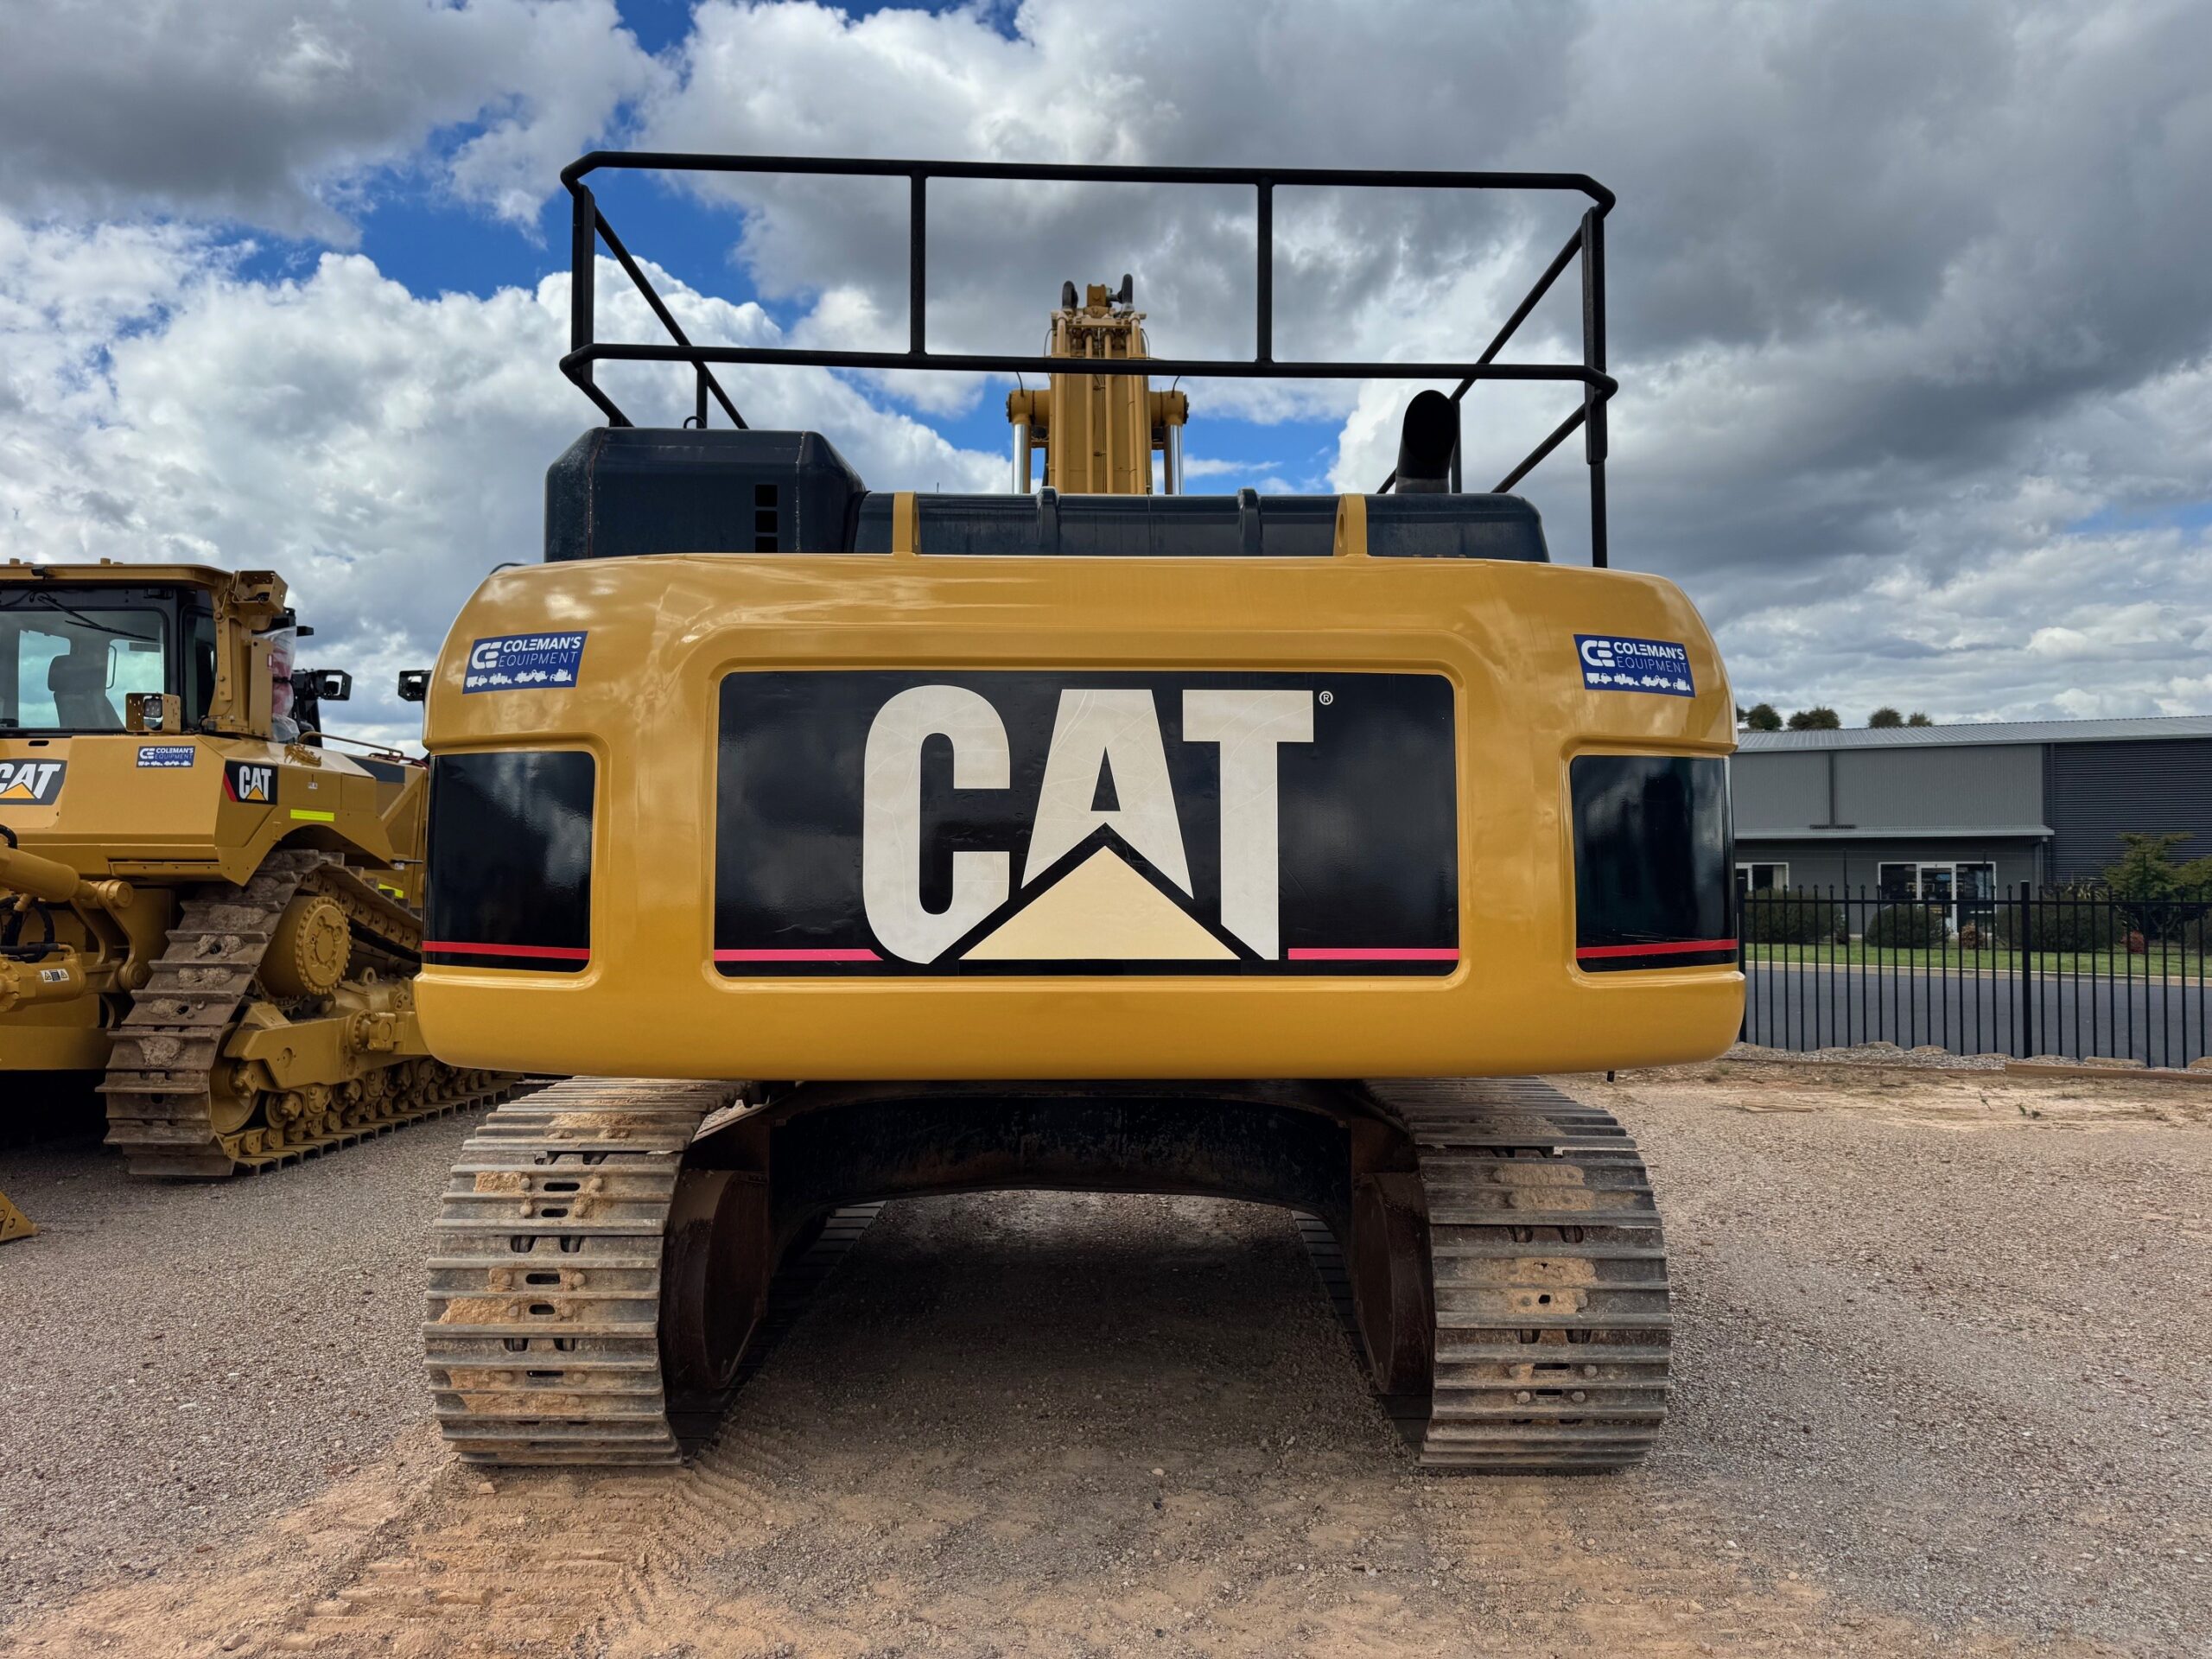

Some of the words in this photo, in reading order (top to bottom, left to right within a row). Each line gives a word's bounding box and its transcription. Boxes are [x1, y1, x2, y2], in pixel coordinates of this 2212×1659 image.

[503, 636, 582, 653] COLEMAN'S
[1613, 641, 1685, 661] COLEMAN'S
[499, 651, 579, 668] EQUIPMENT
[1617, 656, 1688, 674] EQUIPMENT
[238, 766, 272, 802] CAT
